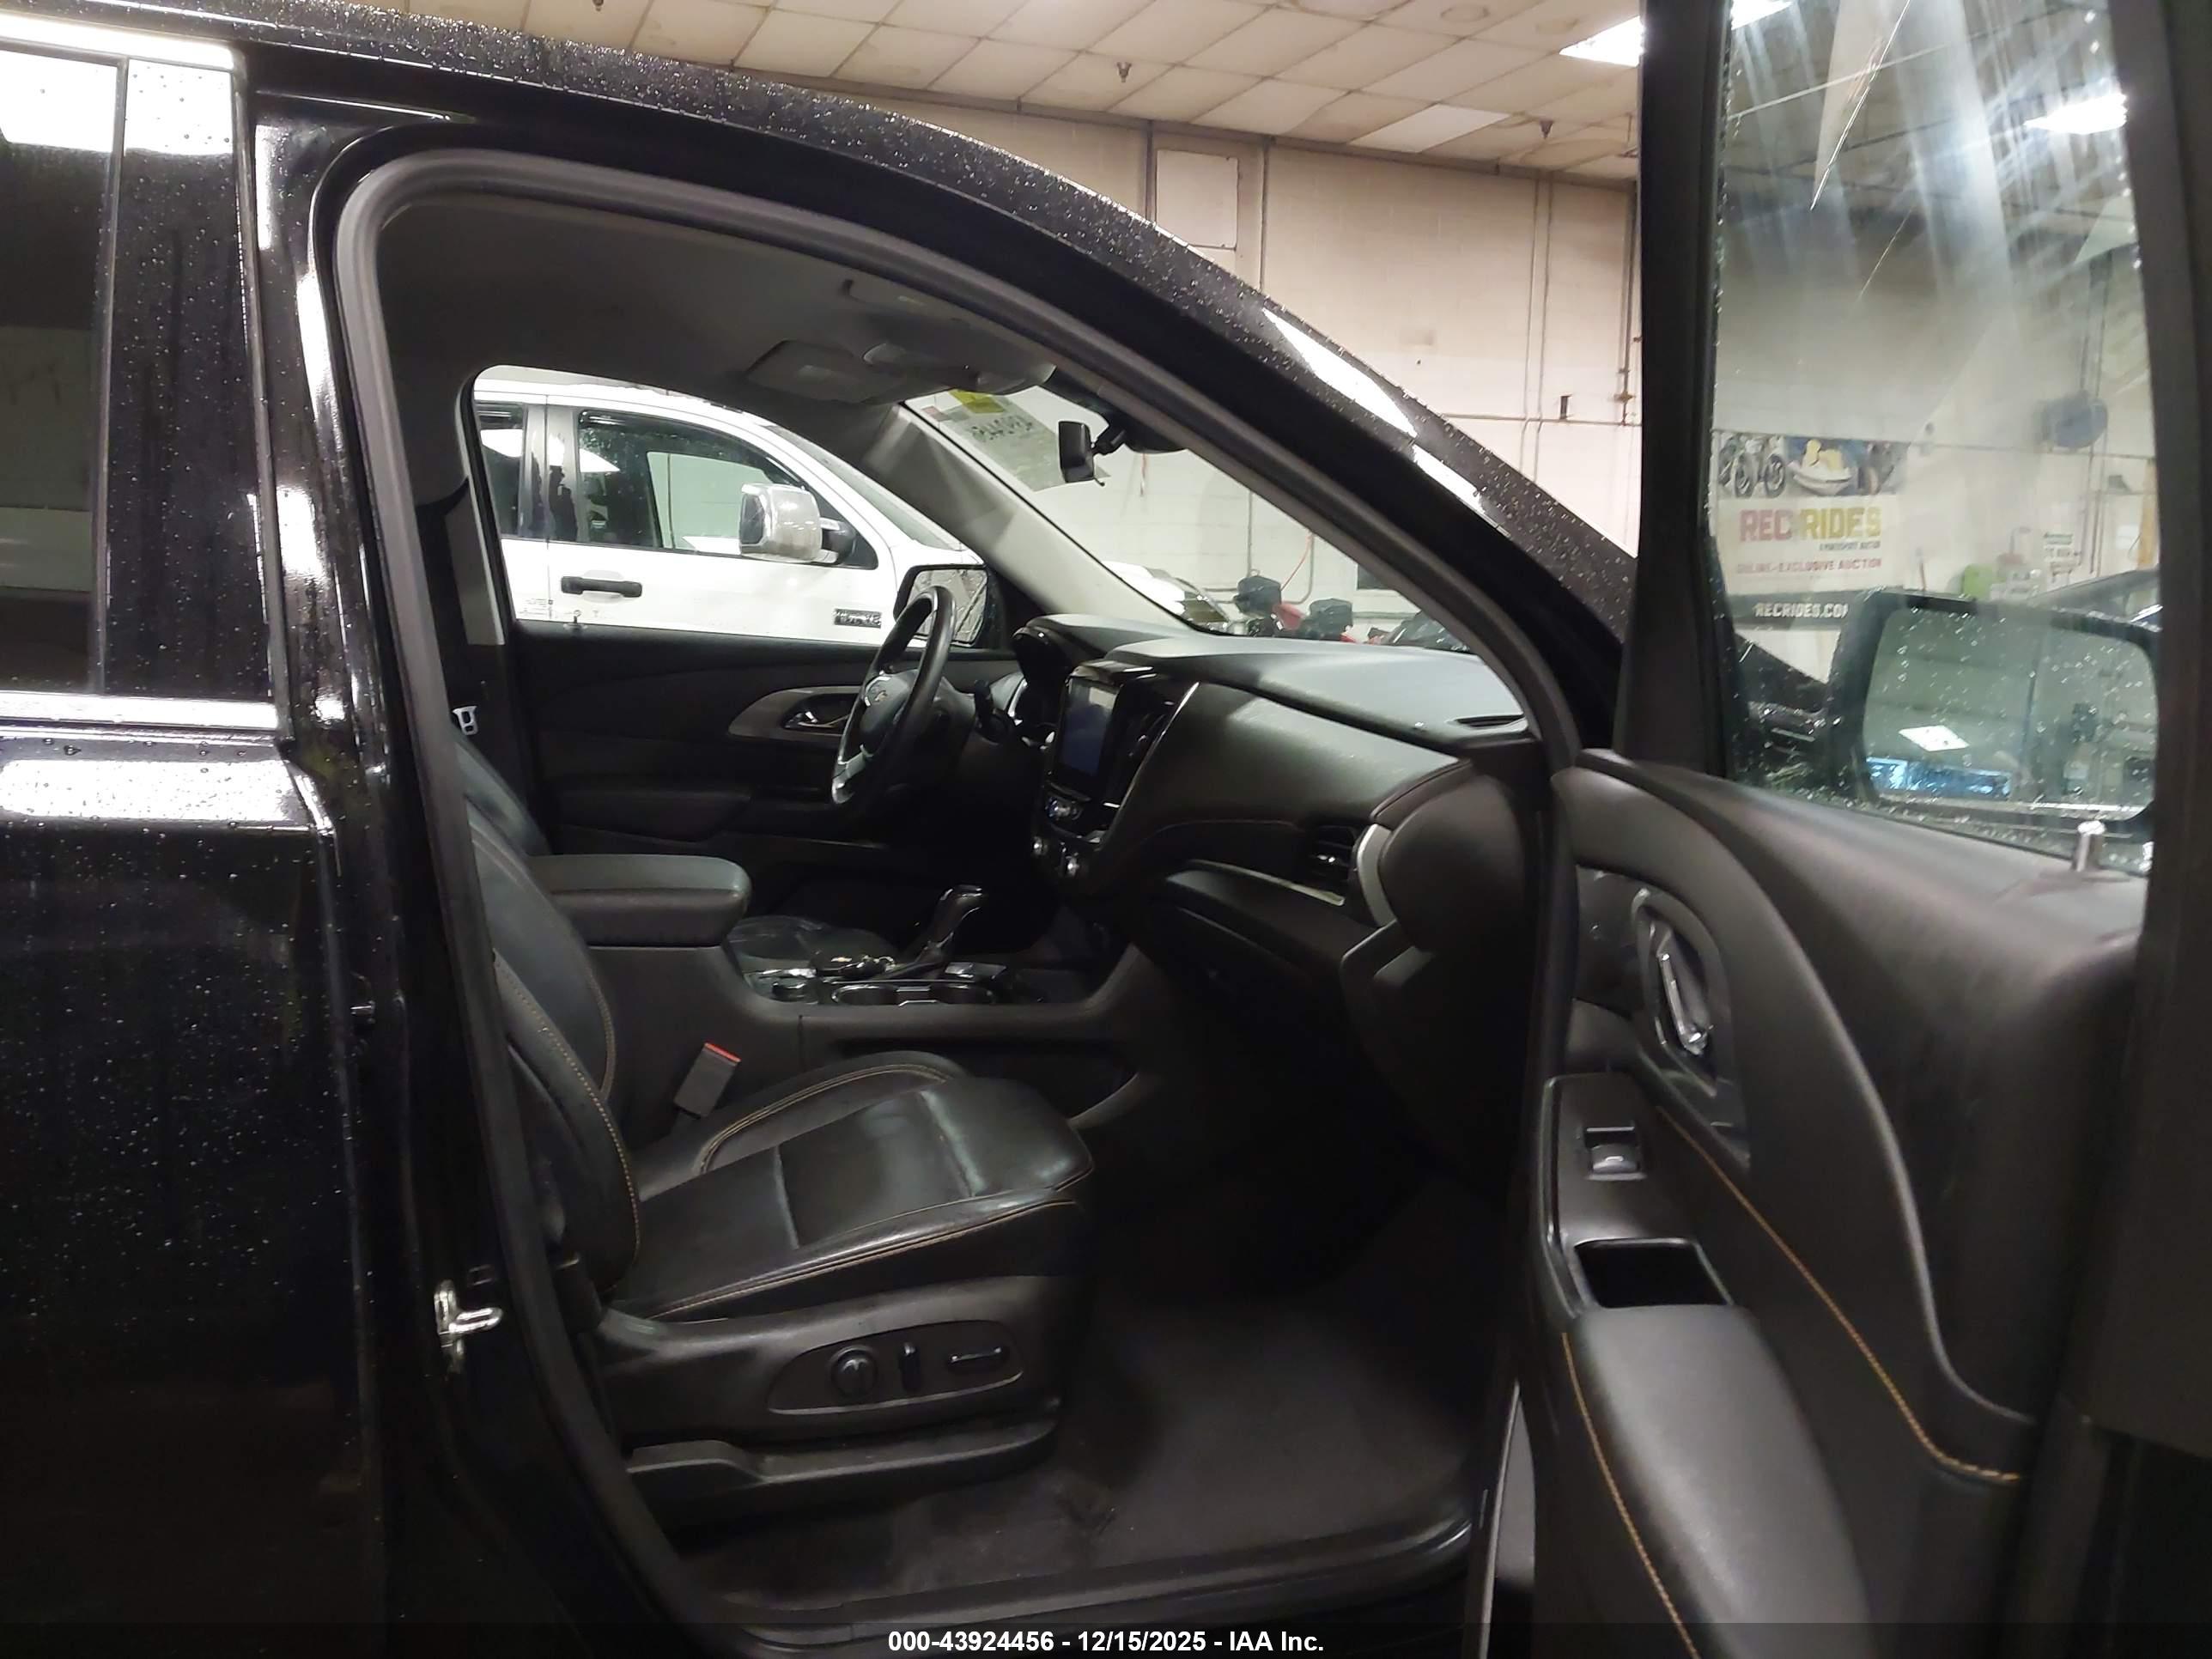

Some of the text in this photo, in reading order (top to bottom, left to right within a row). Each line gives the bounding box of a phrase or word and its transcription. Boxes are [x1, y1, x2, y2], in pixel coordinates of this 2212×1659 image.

[1739, 507, 1882, 542] REC RIDES
[1838, 558, 1882, 570] AUCTION
